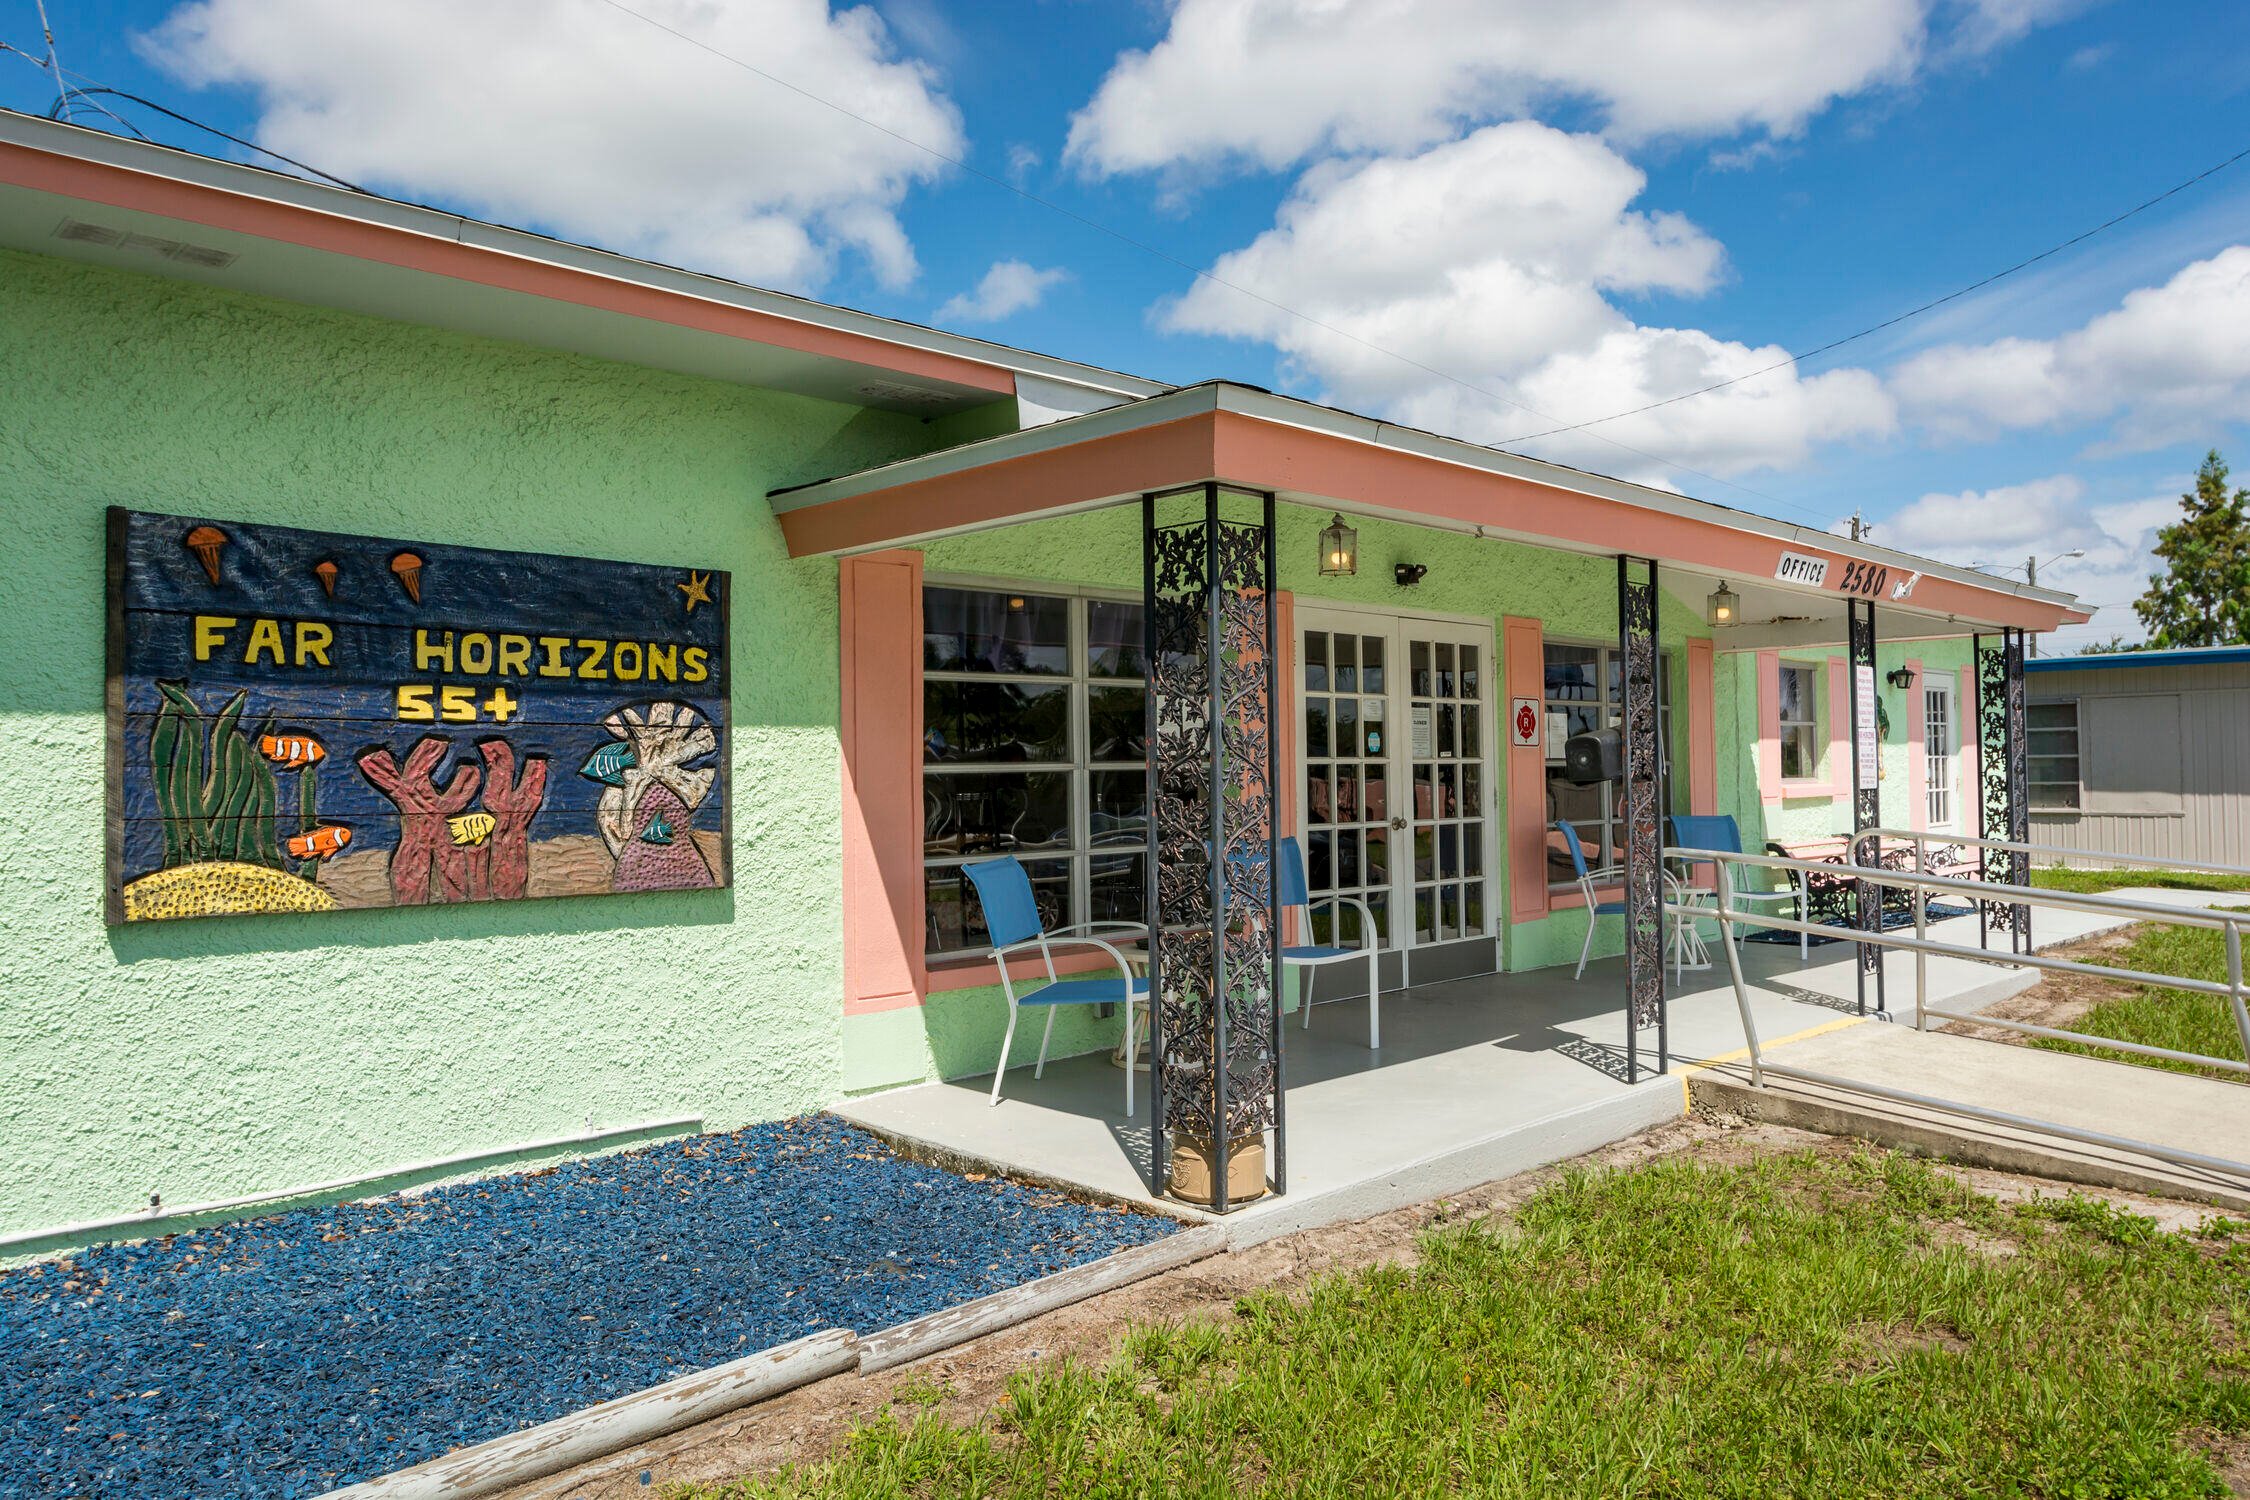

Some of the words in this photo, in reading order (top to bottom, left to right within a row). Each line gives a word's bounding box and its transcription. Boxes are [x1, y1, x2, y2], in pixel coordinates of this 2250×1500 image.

[1782, 557, 1824, 582] OFFICE
[1840, 561, 1887, 596] 2580
[195, 615, 333, 666] FAR
[415, 629, 708, 682] HORIZONS
[398, 685, 517, 722] 55+
[1523, 717, 1529, 728] R
